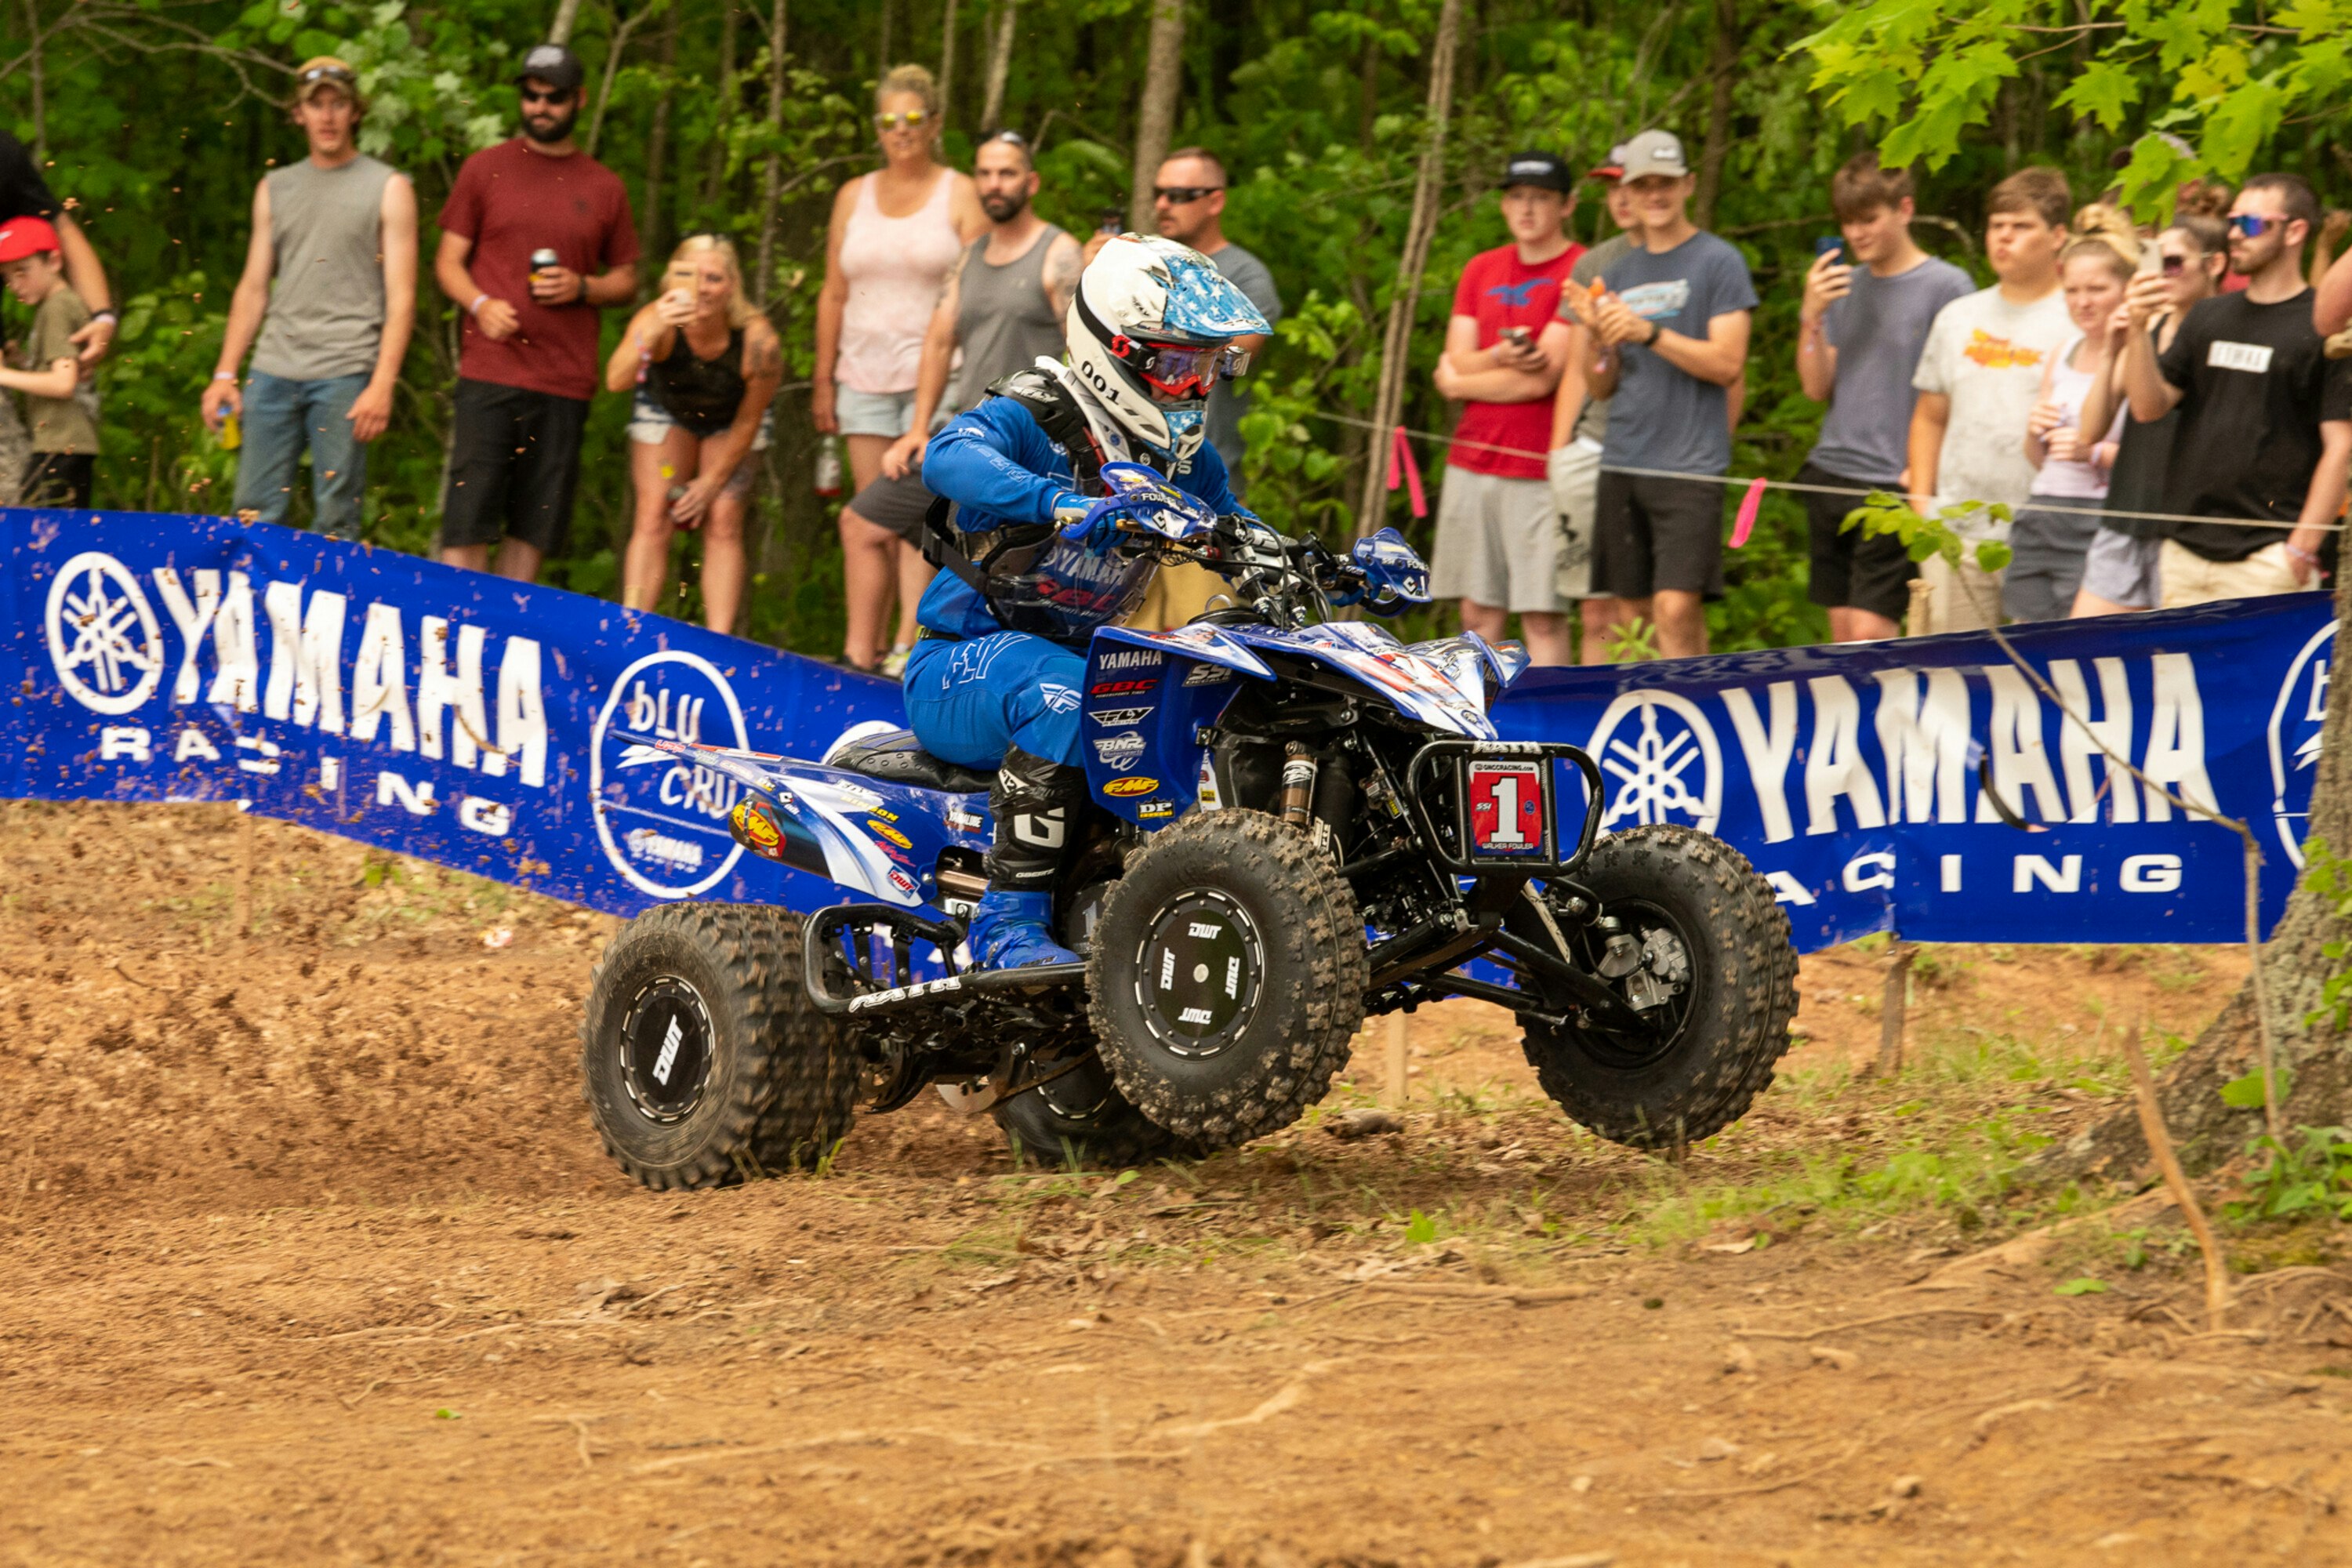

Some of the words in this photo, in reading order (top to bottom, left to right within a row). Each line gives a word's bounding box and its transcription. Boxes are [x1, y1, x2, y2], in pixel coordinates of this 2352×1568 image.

[1081, 360, 1120, 406] 001
[1100, 650, 1163, 670] YAMAHA
[152, 568, 547, 787] YAMAHA
[1091, 679, 1160, 695] GBC
[1088, 706, 1156, 724] FLY
[1102, 737, 1145, 752] BNR
[1718, 653, 2220, 844] YAMAHA
[1103, 779, 1159, 794] FMF
[1139, 802, 1172, 813] DP
[1491, 777, 1524, 843] 1
[1764, 852, 2183, 906] ACING
[1188, 922, 1223, 940] DWT
[1160, 947, 1176, 991] DWT
[652, 1014, 683, 1086] DWT
